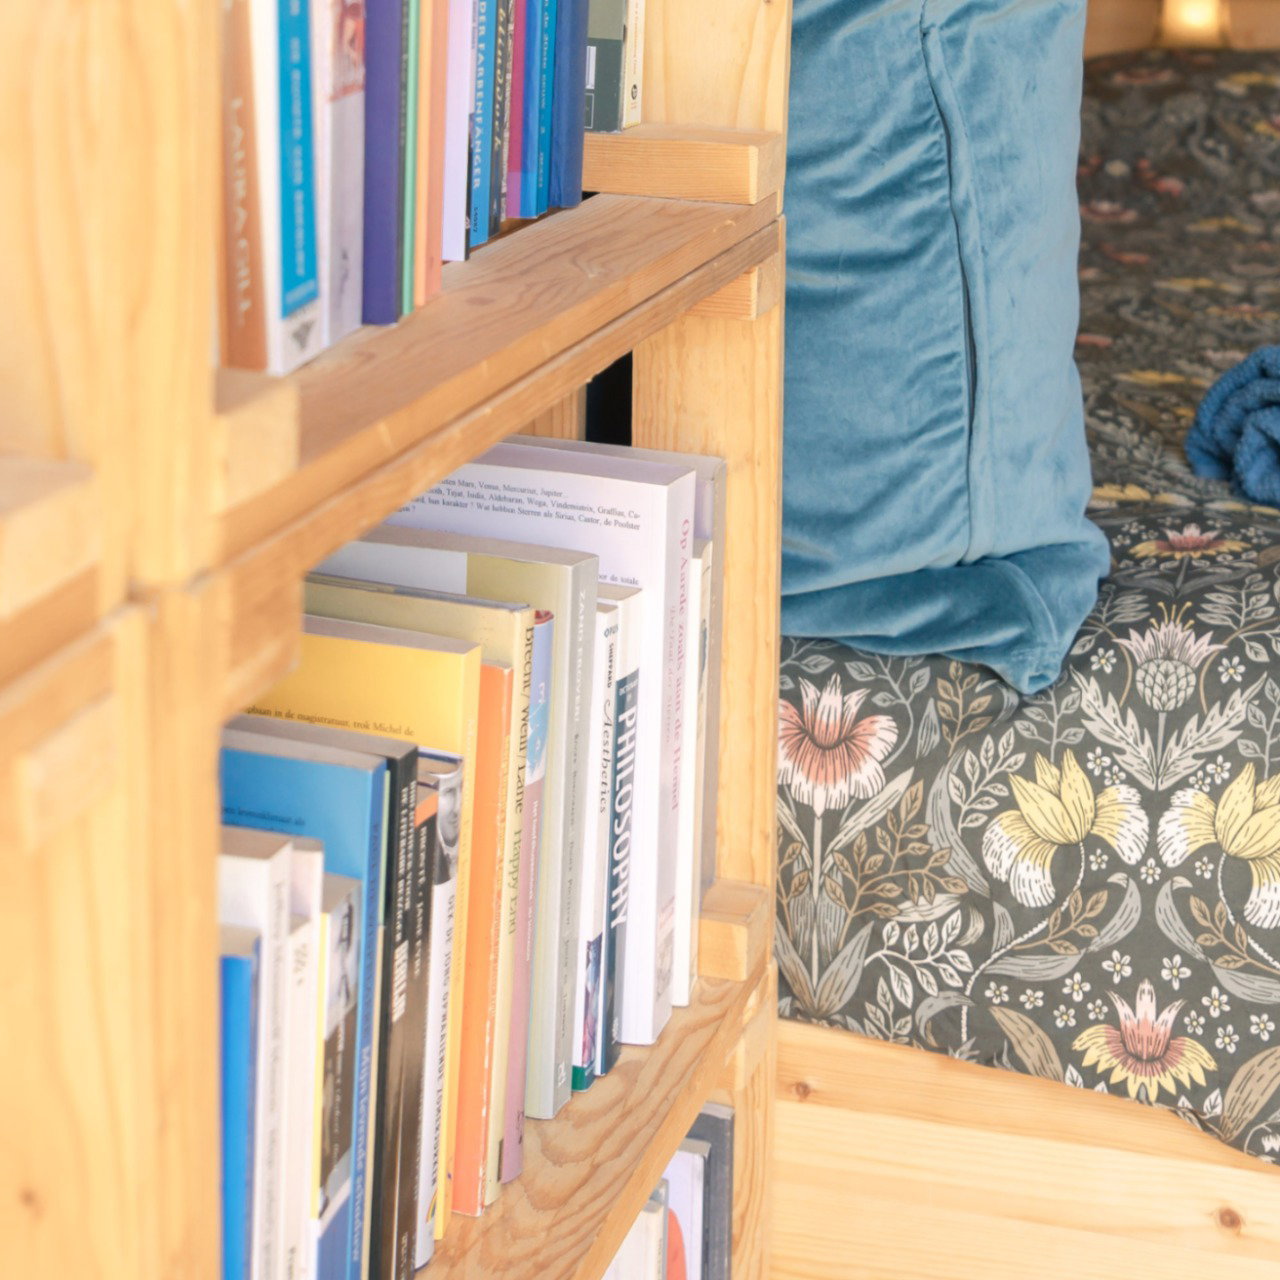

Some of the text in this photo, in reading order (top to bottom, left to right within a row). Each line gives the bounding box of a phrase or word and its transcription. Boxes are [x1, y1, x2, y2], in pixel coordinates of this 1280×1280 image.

[478, 0, 486, 38] DER
[473, 41, 485, 190] FARBENFÄNGER
[372, 722, 402, 735] Michel
[404, 726, 415, 736] de
[600, 699, 613, 814] Aesthetics
[610, 705, 637, 930] PHILOSOPHY
